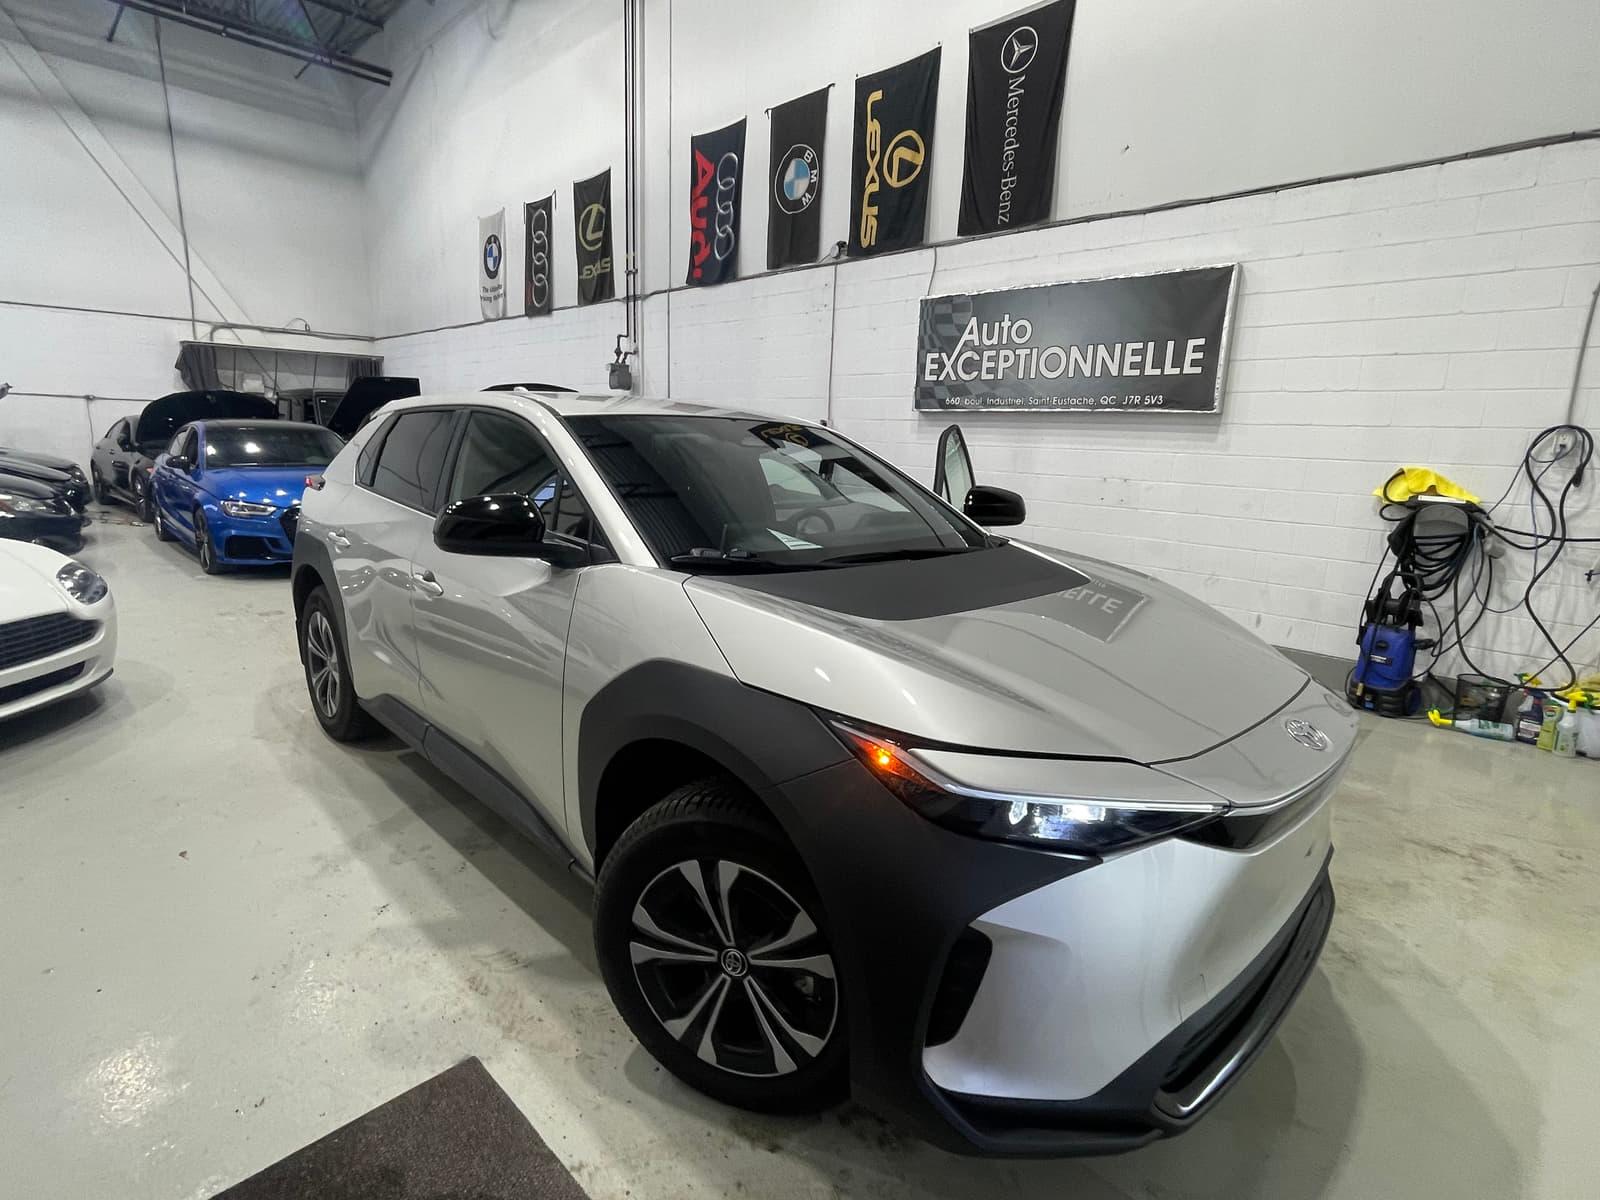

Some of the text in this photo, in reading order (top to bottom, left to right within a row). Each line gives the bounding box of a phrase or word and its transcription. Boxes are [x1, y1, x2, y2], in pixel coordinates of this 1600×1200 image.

[860, 89, 883, 249] LEXUS
[998, 74, 1026, 225] Mercedes-Benz
[803, 149, 818, 206] BMW
[958, 313, 1033, 347] Auto
[924, 337, 1206, 382] EXCEPTIONNELLE
[1099, 395, 1117, 405] QC
[1122, 395, 1141, 405] J7R
[1144, 394, 1164, 405] 5V3
